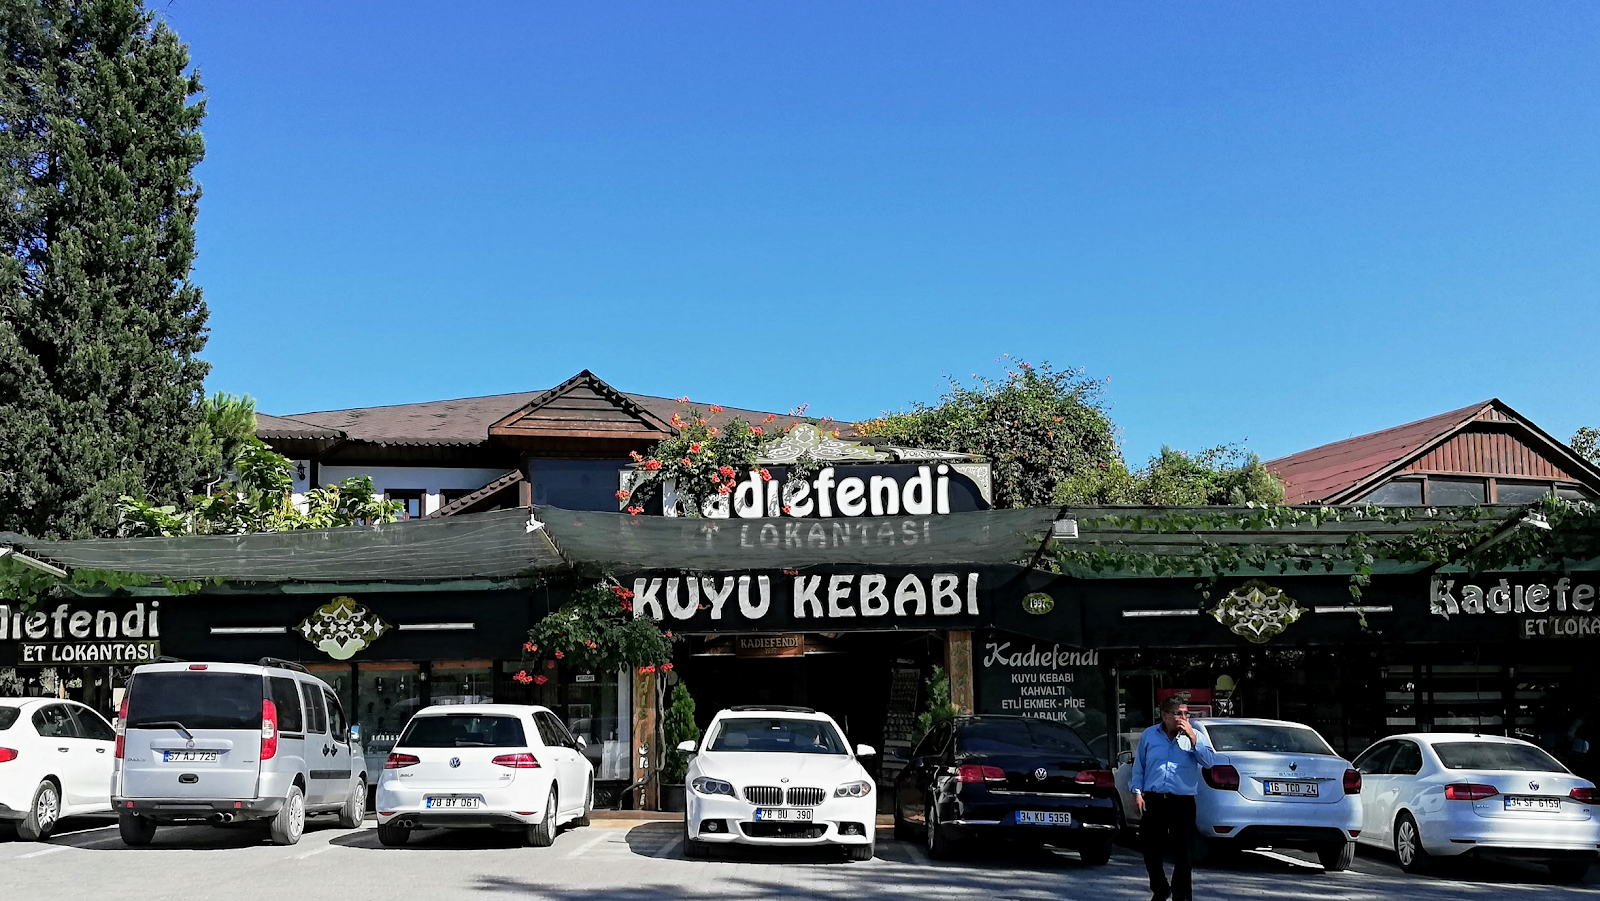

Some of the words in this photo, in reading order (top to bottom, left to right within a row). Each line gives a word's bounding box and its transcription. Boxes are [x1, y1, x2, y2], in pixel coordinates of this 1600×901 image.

[633, 576, 770, 620] KUYU
[794, 573, 979, 618] KEBABI
[1030, 598, 1046, 609] 1997
[1525, 619, 1547, 635] ET
[23, 646, 46, 661] ET
[52, 643, 155, 661] LOKANTASI
[1011, 674, 1037, 683] KUYU
[1039, 673, 1074, 683] KEBABI
[1021, 686, 1065, 696] KAHVALTI
[1002, 697, 1021, 709] ETLİ
[1024, 699, 1057, 708] EKMEK
[1064, 697, 1085, 708] PİDE
[168, 751, 180, 761] 57
[183, 751, 196, 761] AJ
[199, 751, 217, 761] 729
[1270, 782, 1280, 792] 16
[1306, 784, 1316, 794] 24
[445, 797, 458, 807] BY
[1511, 797, 1522, 807] 34
[1524, 797, 1535, 807] SF
[762, 809, 773, 819] 78
[777, 809, 788, 819] BU
[796, 810, 811, 819] 390
[1020, 811, 1031, 821] 34
[1034, 812, 1045, 822] KU
[1048, 813, 1070, 823] 5356
